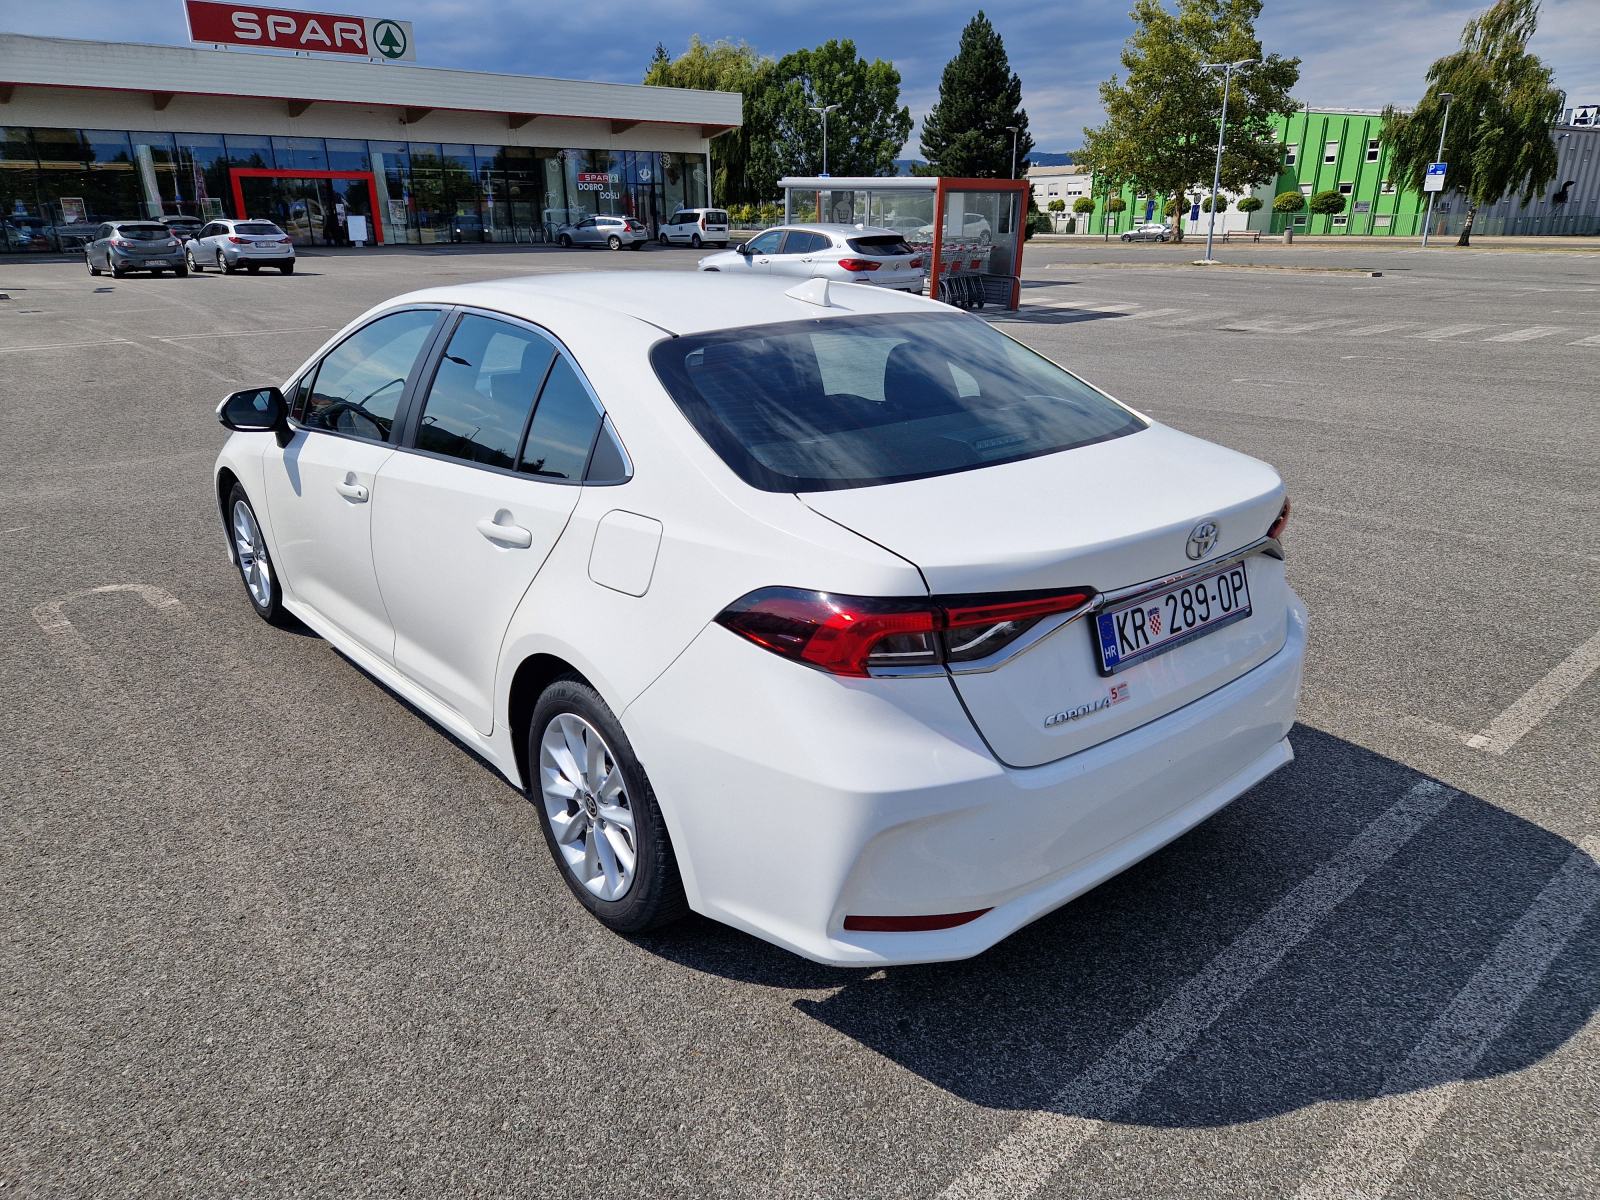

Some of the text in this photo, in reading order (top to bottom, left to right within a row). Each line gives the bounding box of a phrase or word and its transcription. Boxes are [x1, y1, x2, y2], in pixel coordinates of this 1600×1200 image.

[231, 11, 364, 49] SPAR
[1429, 164, 1436, 173] P
[584, 174, 609, 182] SPAR
[578, 183, 604, 191] DOBRO
[1116, 607, 1150, 655] KR
[1104, 645, 1117, 660] HR
[1110, 687, 1118, 700] 5
[1044, 696, 1111, 728] COROLLA
